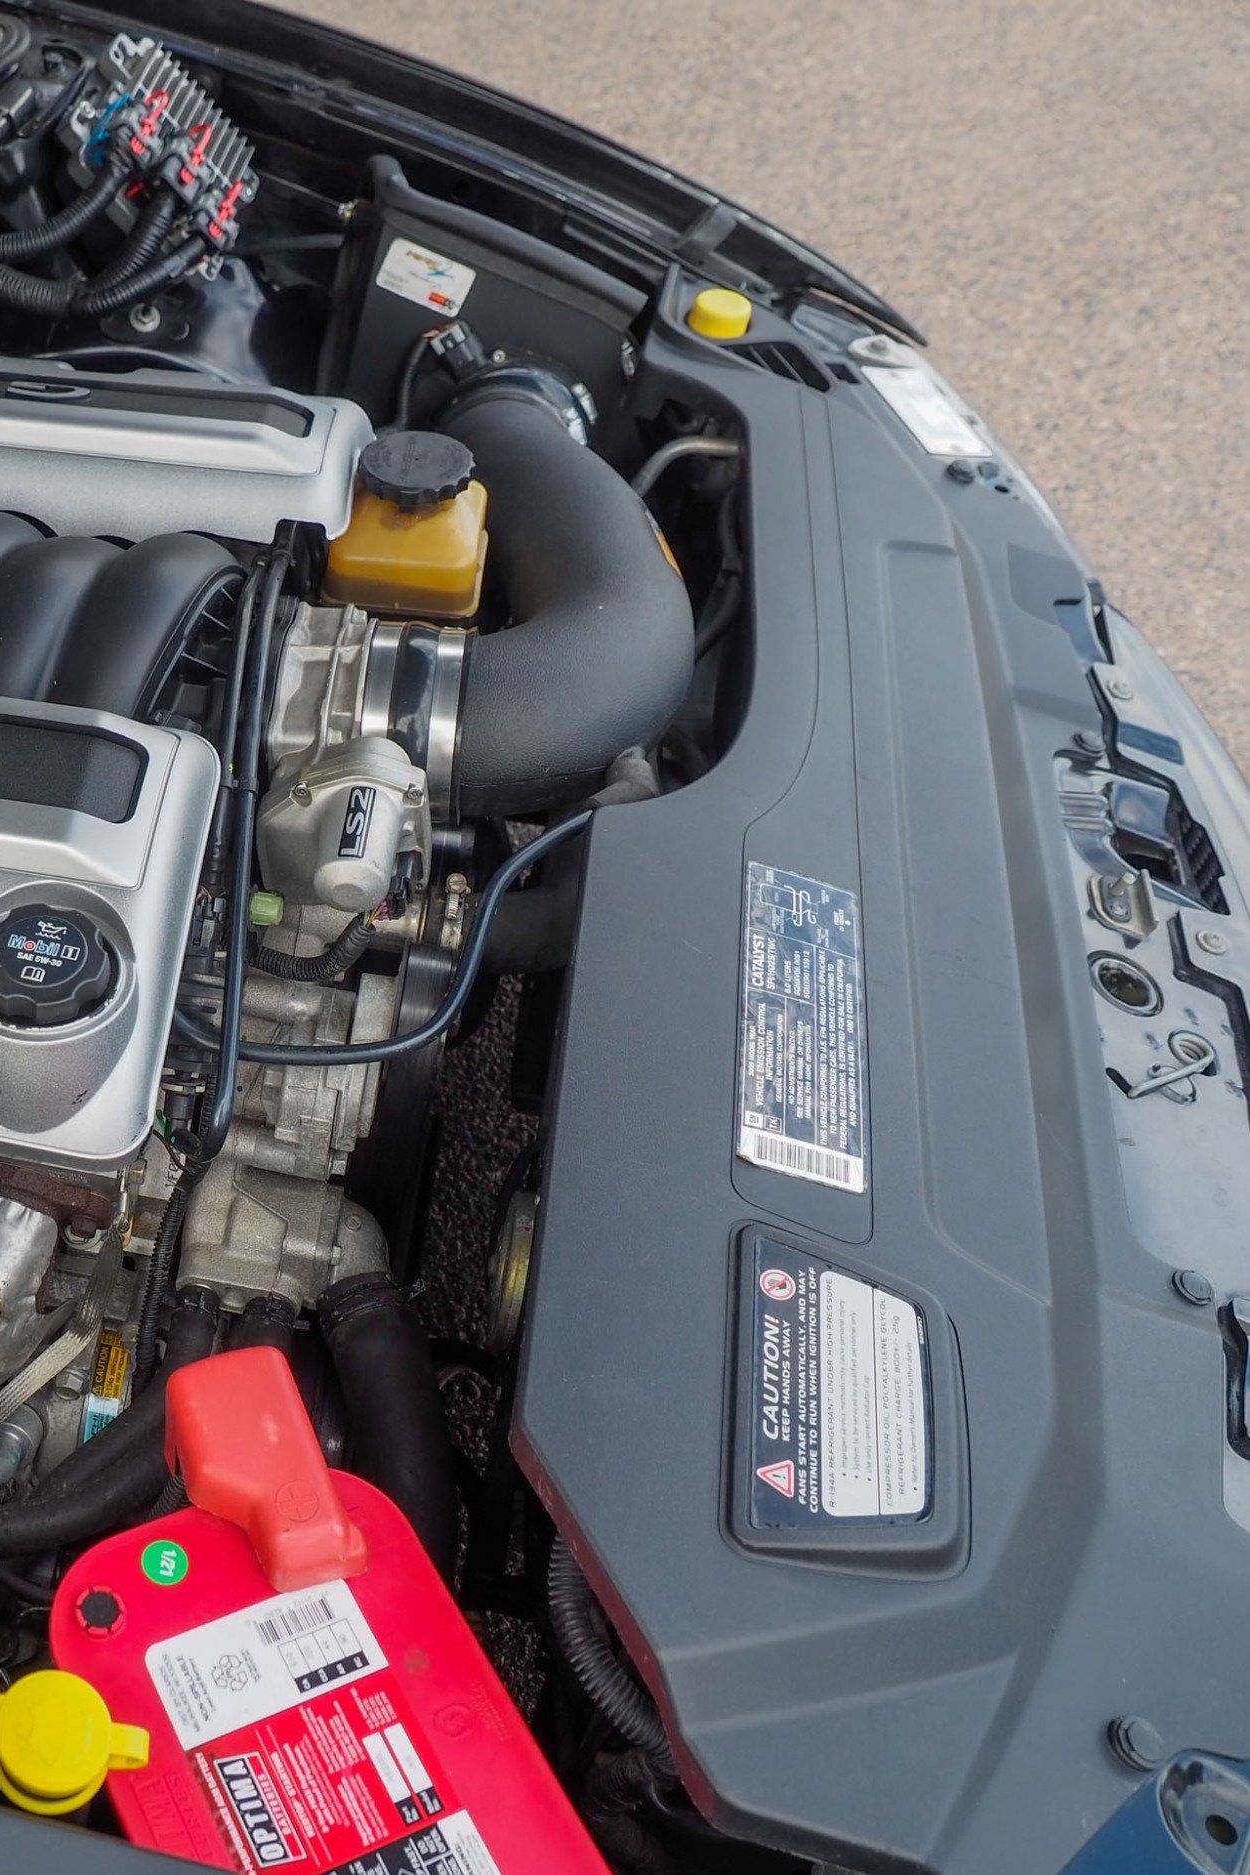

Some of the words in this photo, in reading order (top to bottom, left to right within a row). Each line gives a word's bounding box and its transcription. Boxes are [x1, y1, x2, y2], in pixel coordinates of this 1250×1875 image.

[340, 788, 370, 855] LS2
[7, 934, 61, 957] Mobil
[16, 952, 34, 962] SAE
[34, 954, 63, 967] 5W-30
[750, 932, 765, 987] CATALYST
[757, 1001, 766, 1035] CONTROL
[756, 1035, 765, 1073] EMISSION
[765, 1028, 773, 1081] INFORMATION
[755, 1073, 763, 1106] VEHICLE
[798, 1297, 806, 1322] AND
[809, 1291, 816, 1304] IS
[825, 1278, 833, 1330] PRESSURE
[782, 1319, 790, 1357] AWAY
[808, 1306, 817, 1356] IGNITION
[94, 1345, 109, 1383] CAUTION
[762, 1313, 779, 1440] CAUTION!
[782, 1359, 790, 1404] HANDS
[809, 1359, 817, 1396] WHEN
[782, 1408, 790, 1441] KEEP
[809, 1399, 817, 1425] RUN
[798, 1424, 806, 1465] START
[809, 1429, 817, 1444] TO
[826, 1397, 835, 1468] REFRIGERANT
[883, 1432, 893, 1505] COMPRESSOR
[895, 1422, 905, 1494] REFRIGERANT
[798, 1468, 807, 1504] FANS
[809, 1449, 818, 1512] CONTINUE
[221, 1758, 286, 1865] OPTIMA
[256, 1772, 292, 1836] BATTERIES
